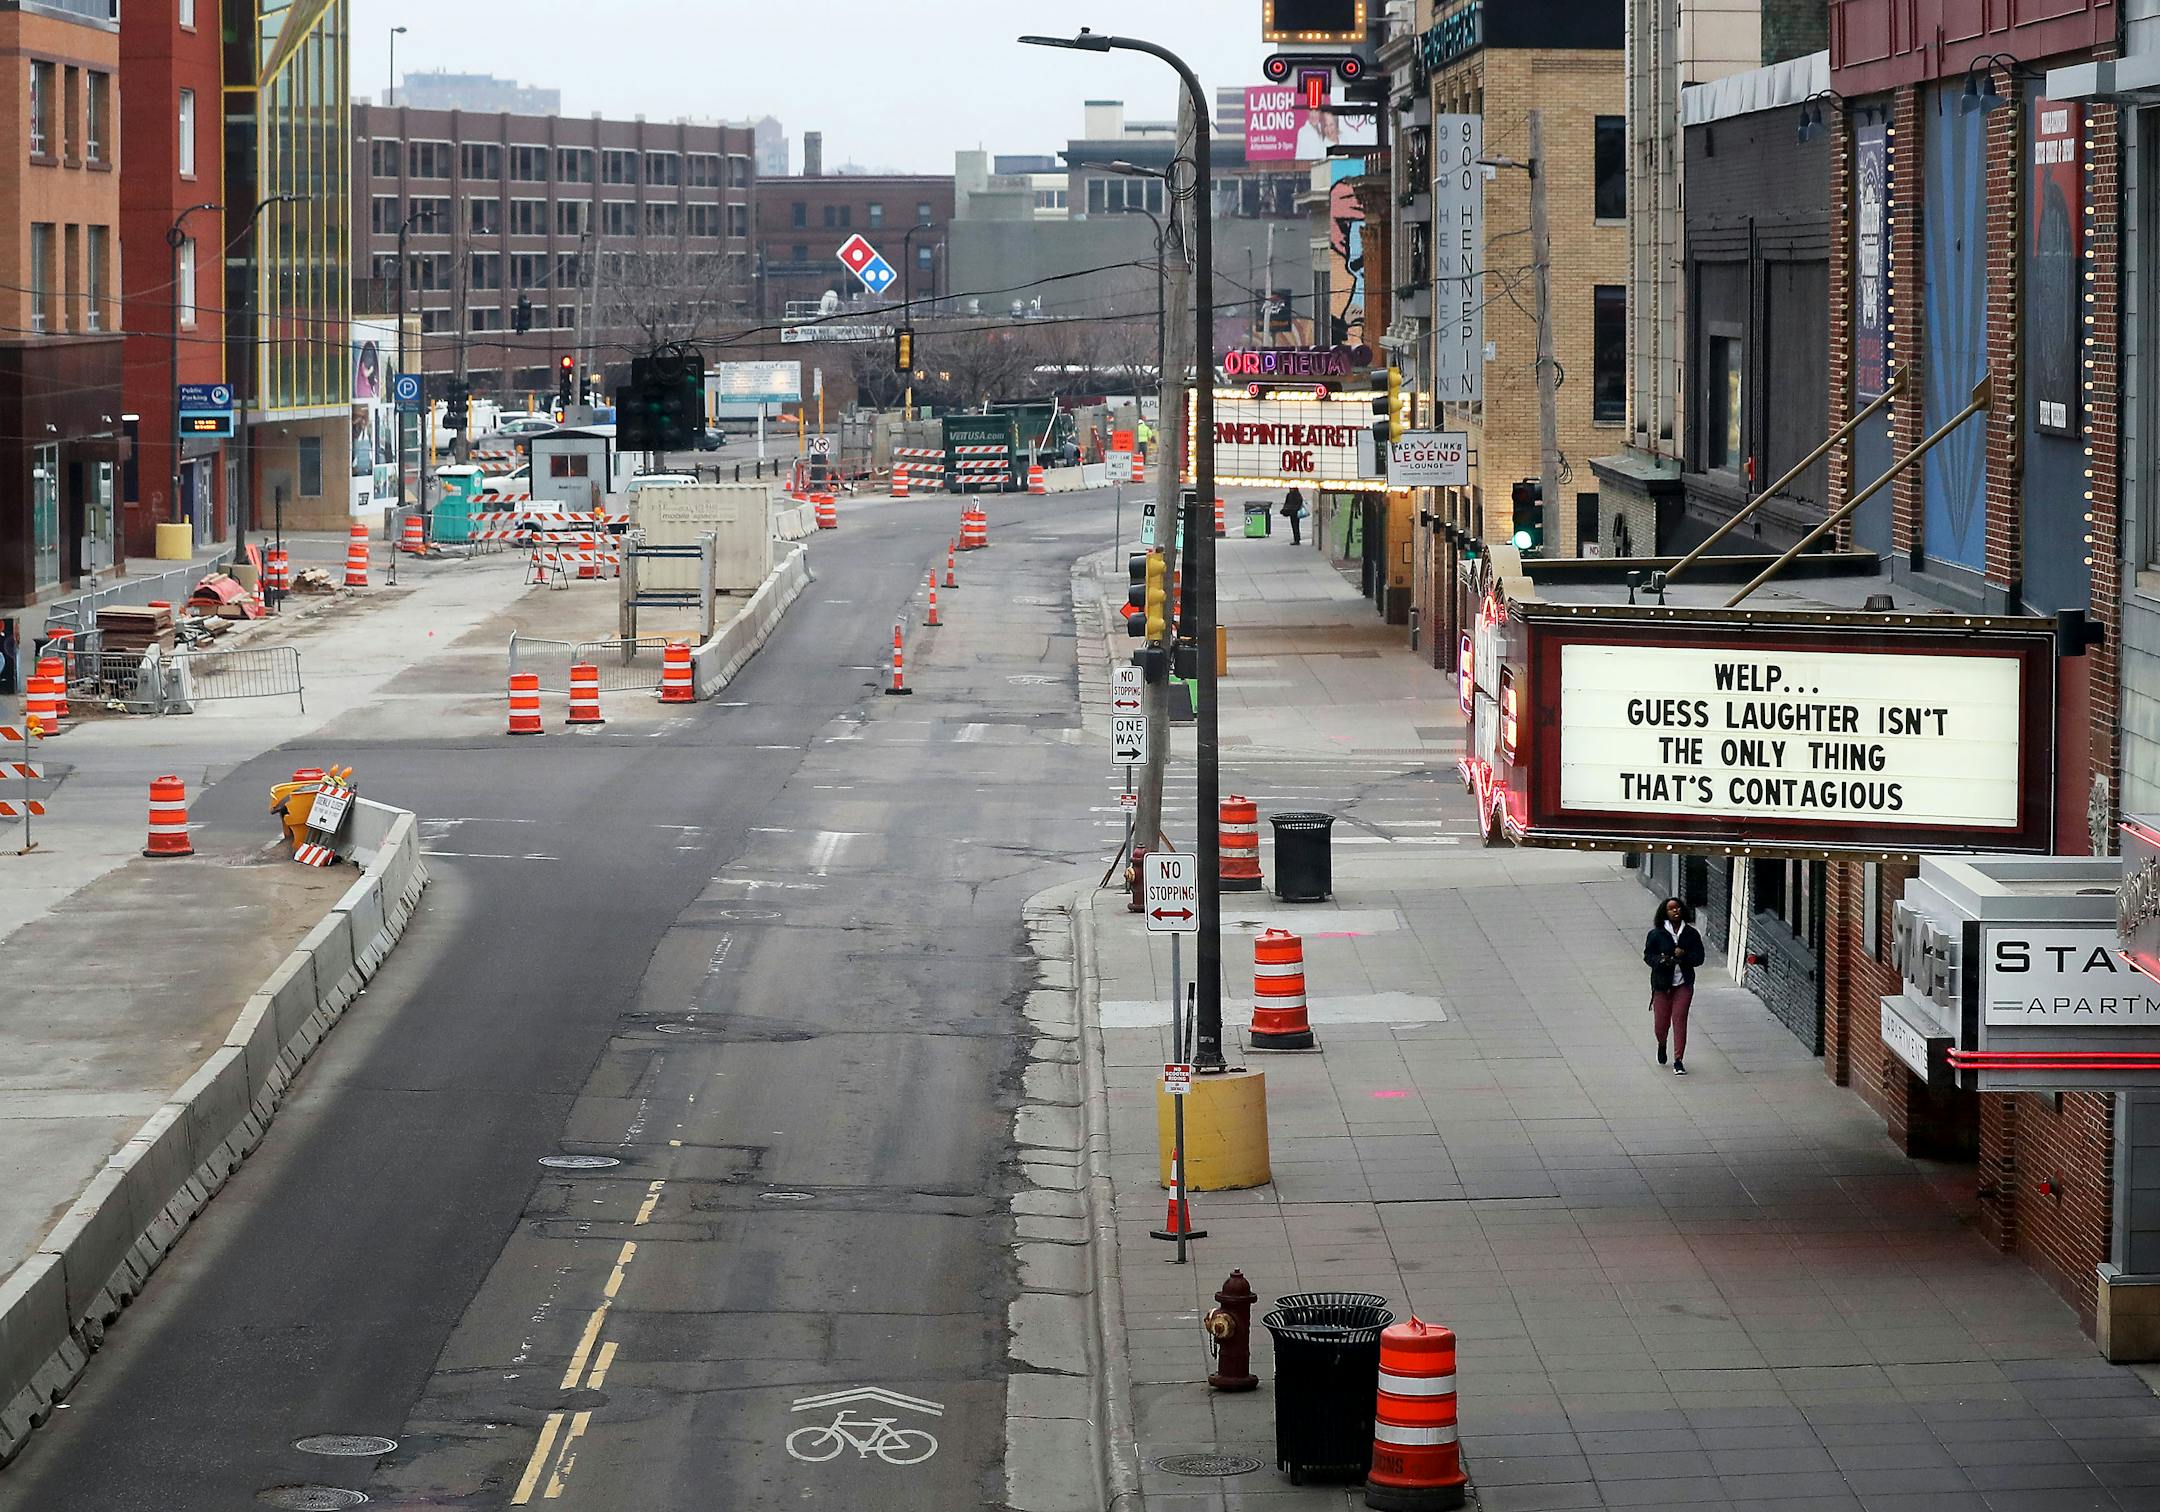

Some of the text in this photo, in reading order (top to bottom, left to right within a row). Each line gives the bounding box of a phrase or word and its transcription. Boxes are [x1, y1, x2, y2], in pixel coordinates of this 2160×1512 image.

[1250, 91, 1295, 111] LAUGH
[1250, 112, 1295, 131] ALONG
[1461, 122, 1473, 394] 900 HENNEPIN
[1224, 351, 1346, 375] ORPHEUM
[1434, 442, 1462, 450] LINK'S
[1279, 450, 1315, 472] .ORG
[1392, 450, 1461, 462] LEGEND
[1590, 546, 1599, 556] NO
[1121, 671, 1134, 683] NO
[1714, 663, 1819, 694] WELP...
[1114, 686, 1141, 696] STOPPING
[1116, 720, 1143, 732] ONE
[1627, 698, 1948, 736] GUESS LAUGHTER ISN'T
[1115, 733, 1144, 745] WAY
[1658, 737, 1886, 772] THE ONLY THING
[1620, 772, 1903, 811] THAT'S CONTAGIOUS
[1160, 861, 1181, 879] NO
[1149, 886, 1195, 901] STOPPING
[1892, 900, 1951, 1007] STAGE
[1995, 941, 2142, 973] STA
